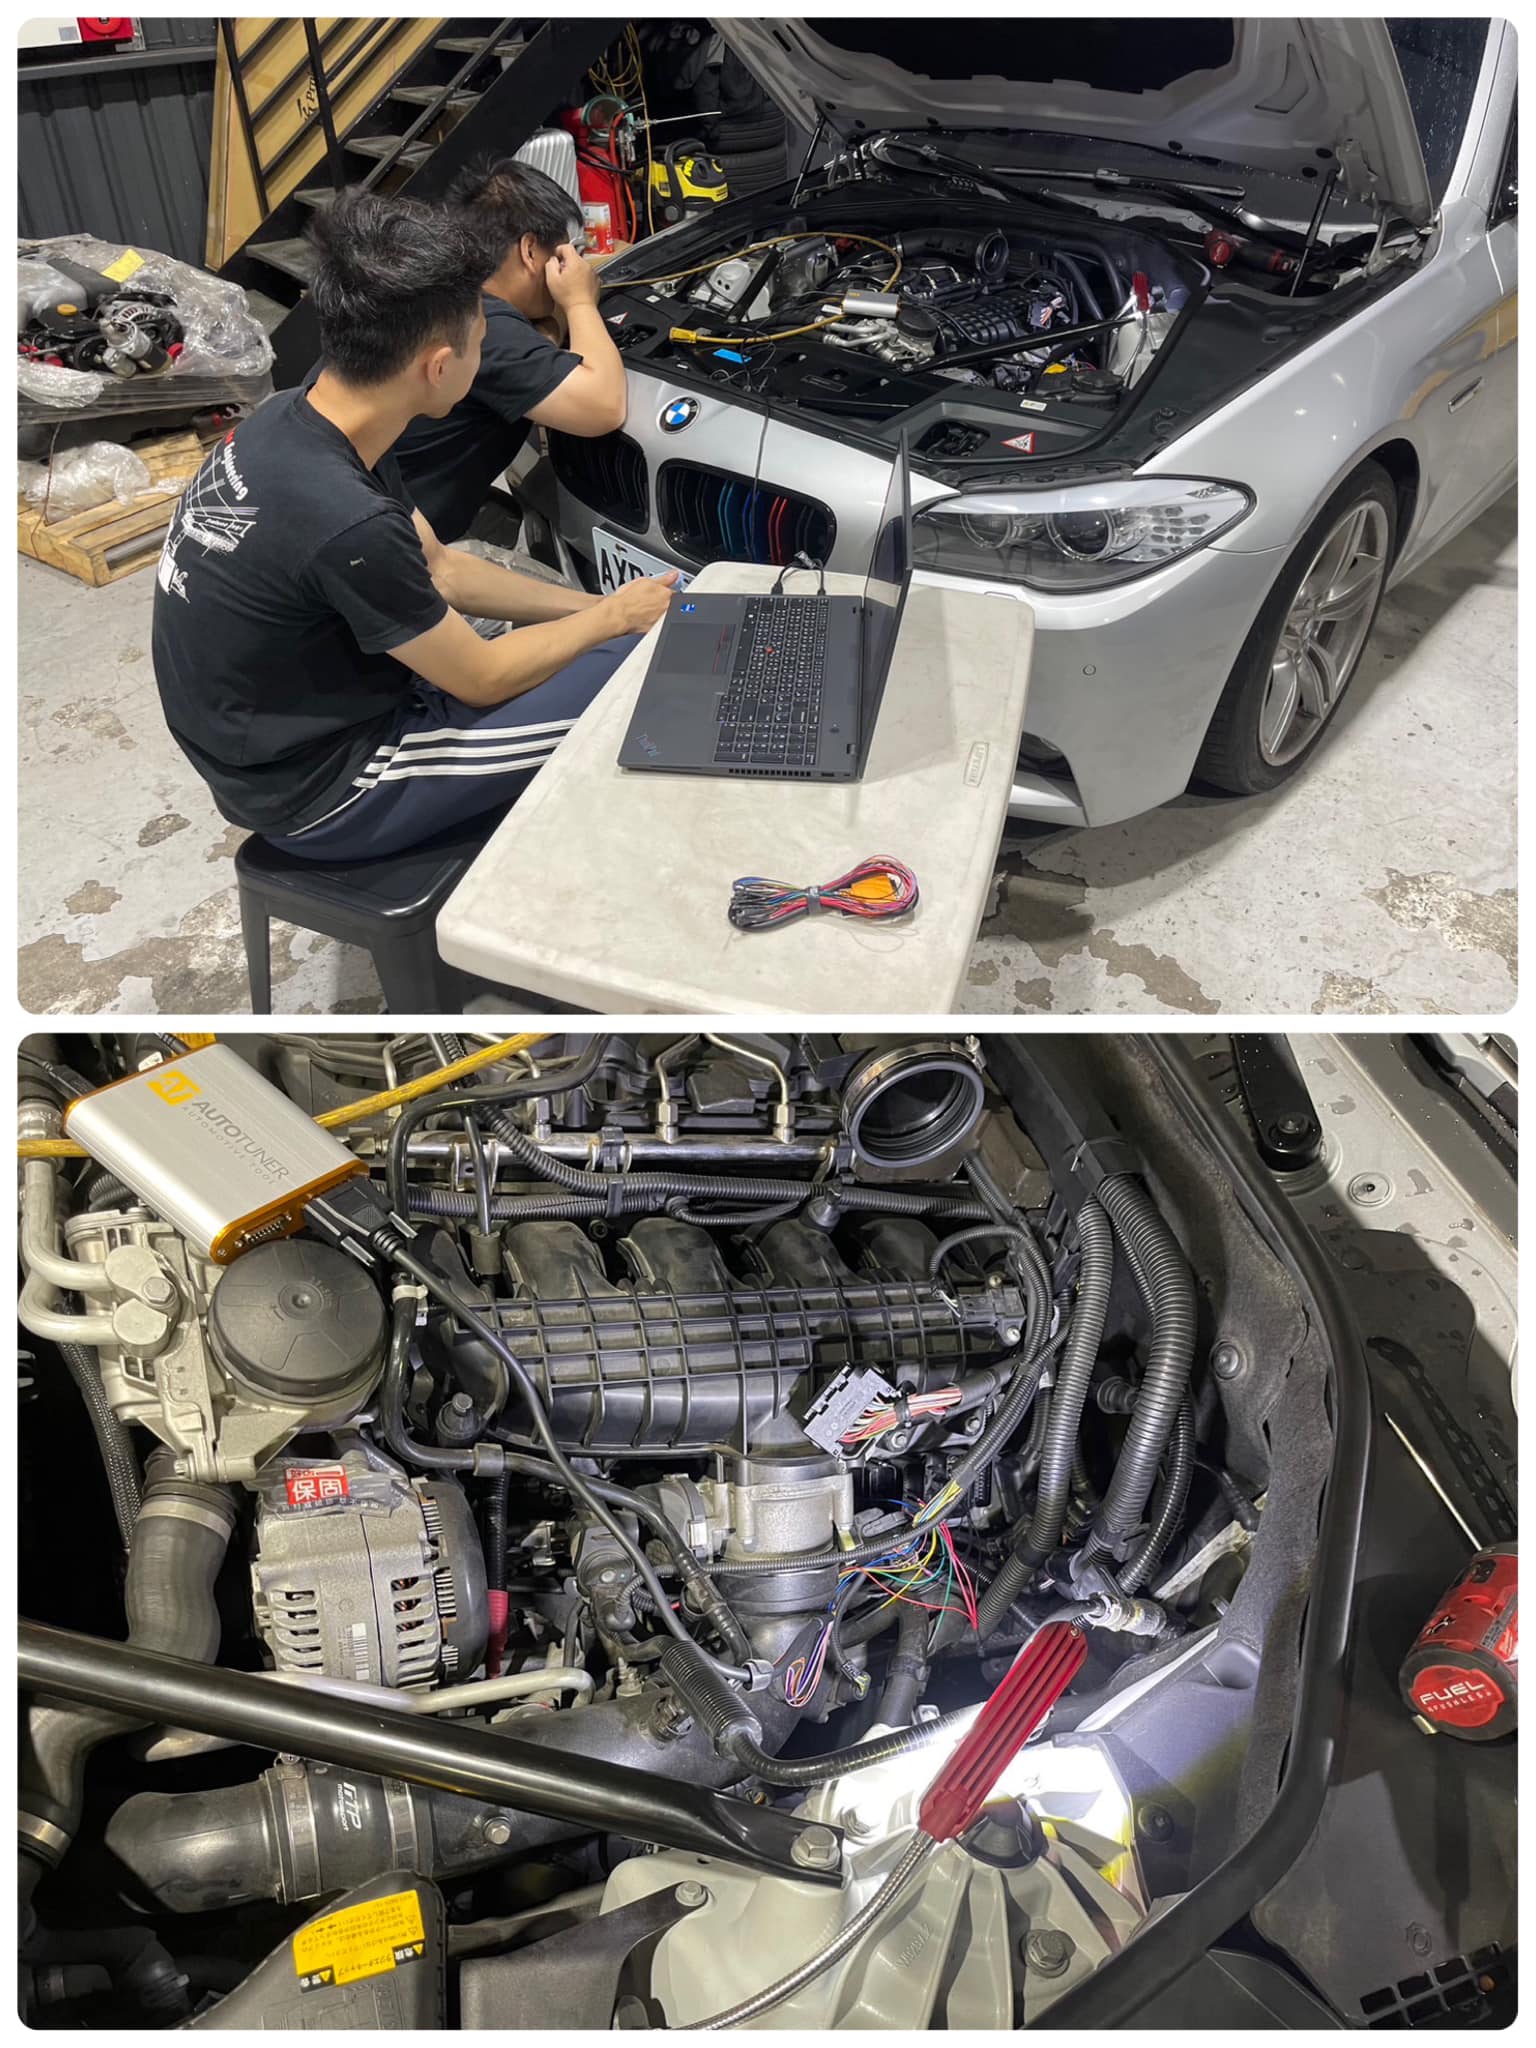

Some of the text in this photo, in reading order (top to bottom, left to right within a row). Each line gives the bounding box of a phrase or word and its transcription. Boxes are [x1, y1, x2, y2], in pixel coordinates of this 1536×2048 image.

[181, 1106, 246, 1159] AUTOMOTIVE
[192, 1100, 290, 1180] AUTOTUNER
[292, 1479, 343, 1502] 保固
[1419, 1680, 1486, 1705] FUEL
